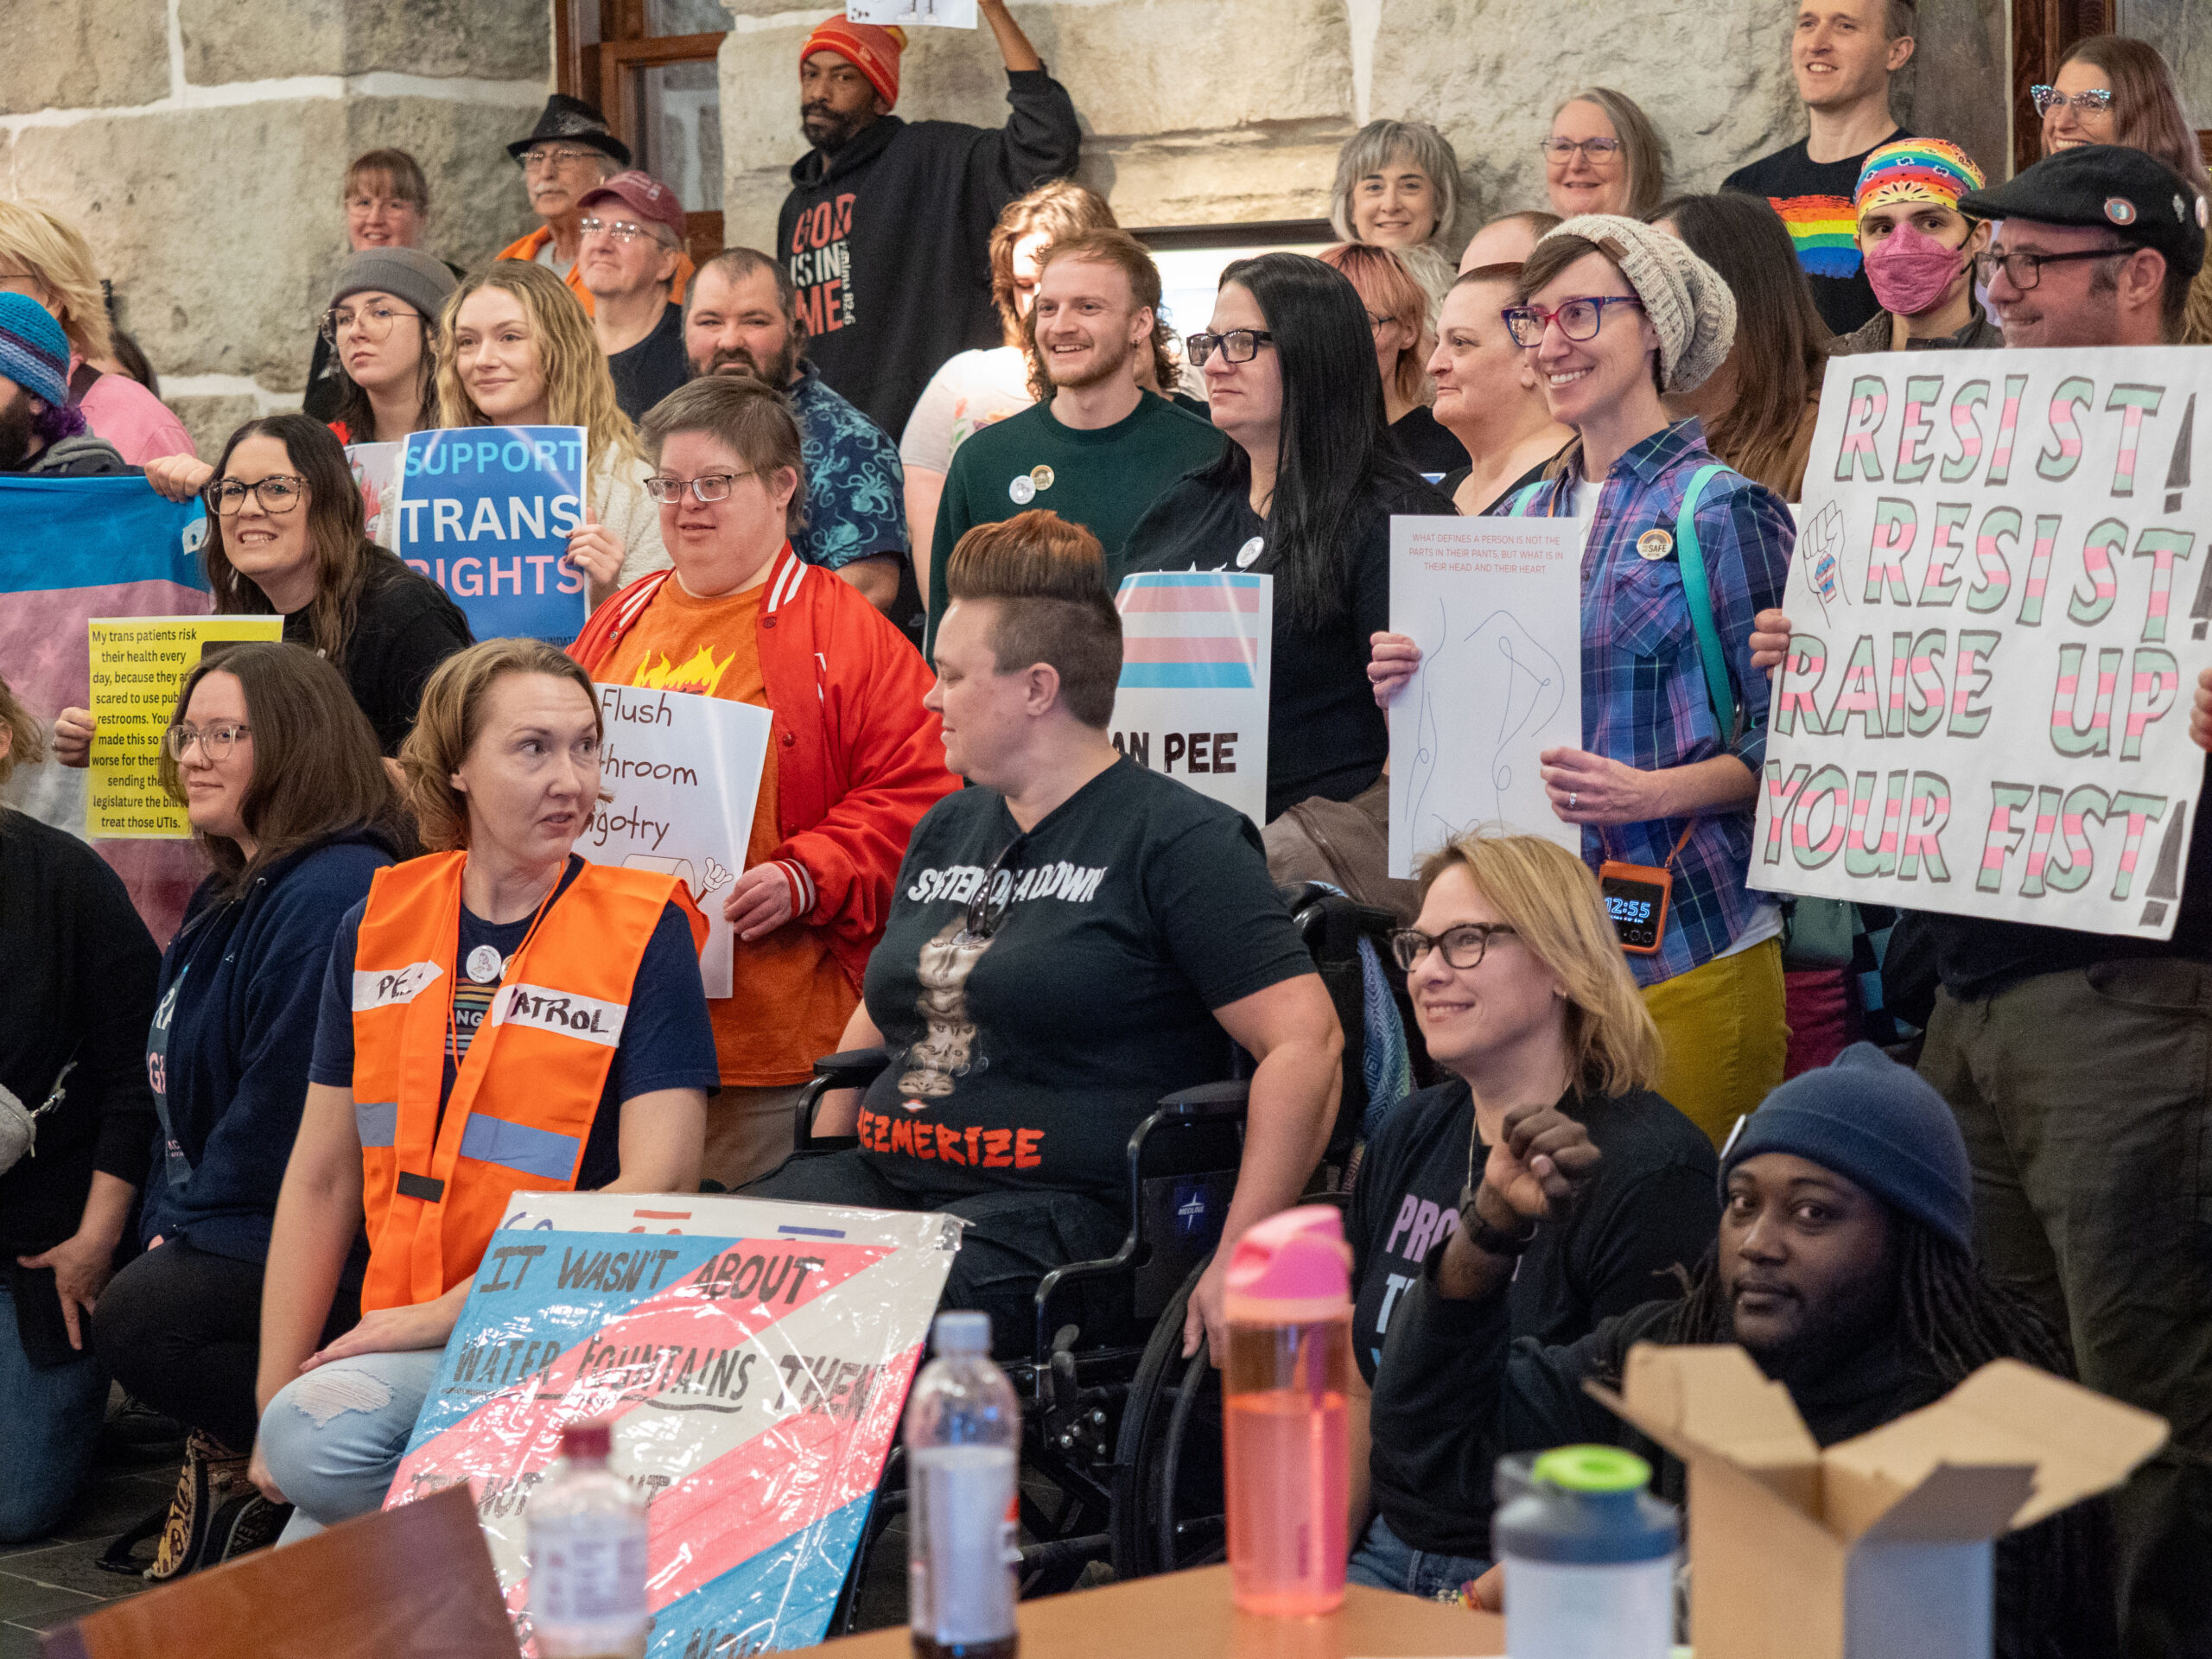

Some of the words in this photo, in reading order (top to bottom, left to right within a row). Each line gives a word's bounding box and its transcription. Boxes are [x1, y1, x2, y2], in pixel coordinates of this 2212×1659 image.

[791, 193, 856, 254] GOD
[790, 252, 814, 287] IS
[815, 242, 842, 283] IN
[795, 278, 844, 337] ME
[1834, 373, 2196, 514] RESIST!
[404, 440, 582, 476] SUPPORT
[401, 494, 582, 543] TRANS
[1413, 533, 1435, 542] WHAT
[1438, 534, 1471, 543] DEFINES
[1482, 535, 1513, 544] PERSON
[1516, 536, 1523, 544] IS
[1526, 536, 1542, 545] NOT
[1545, 537, 1560, 545] THE
[1649, 544, 1667, 553] SAFE
[1409, 548, 1433, 556] PARTS
[1446, 549, 1469, 557] THEIR
[1471, 550, 1499, 560] PANTS,
[1502, 550, 1517, 559] BUT
[1520, 551, 1542, 560] WHAT
[1546, 551, 1553, 560] IS
[1555, 551, 1563, 560] IN
[1424, 562, 1446, 571] THEIR
[1449, 563, 1472, 572] HEAD
[1474, 563, 1492, 572] AND
[1495, 564, 1517, 573] THEIR
[1519, 565, 1548, 574] HEART.
[92, 631, 106, 645] My
[109, 632, 134, 642] trans
[137, 629, 176, 644] patients
[178, 628, 197, 640] risk
[102, 651, 124, 663] their
[127, 650, 158, 663] health
[160, 651, 186, 664] every
[92, 671, 112, 686] day,
[115, 671, 154, 683] because
[156, 671, 177, 685] they
[96, 692, 128, 704] scared
[130, 693, 141, 703] to
[143, 694, 159, 703] use
[1775, 628, 2001, 741] RAISE
[2050, 643, 2179, 762] UP
[601, 688, 672, 727] Flush
[98, 713, 149, 725] restrooms.
[151, 713, 169, 724] You
[99, 733, 124, 746] made
[127, 733, 146, 745] this
[148, 736, 159, 745] so
[92, 756, 119, 766] worse
[121, 753, 136, 766] for
[1112, 732, 1150, 768] AN
[1164, 733, 1238, 774] PEE
[599, 744, 697, 785] throom
[107, 775, 145, 790] sending
[92, 795, 143, 810] legislature
[145, 796, 161, 807] the
[163, 796, 178, 808] bill
[101, 816, 124, 828] treat
[128, 817, 154, 828] those
[156, 817, 181, 829] UTIs.
[1763, 759, 1951, 883] YOUR
[1975, 780, 2187, 927] FIST!
[1605, 896, 1651, 918] 12:55
[511, 988, 609, 1033] ATROL
[480, 1245, 546, 1294] IT
[558, 1247, 679, 1293] WASN'T
[693, 1253, 826, 1306] ABOUT
[454, 1340, 563, 1385] WATER
[577, 1336, 757, 1402] FOUNTAINS
